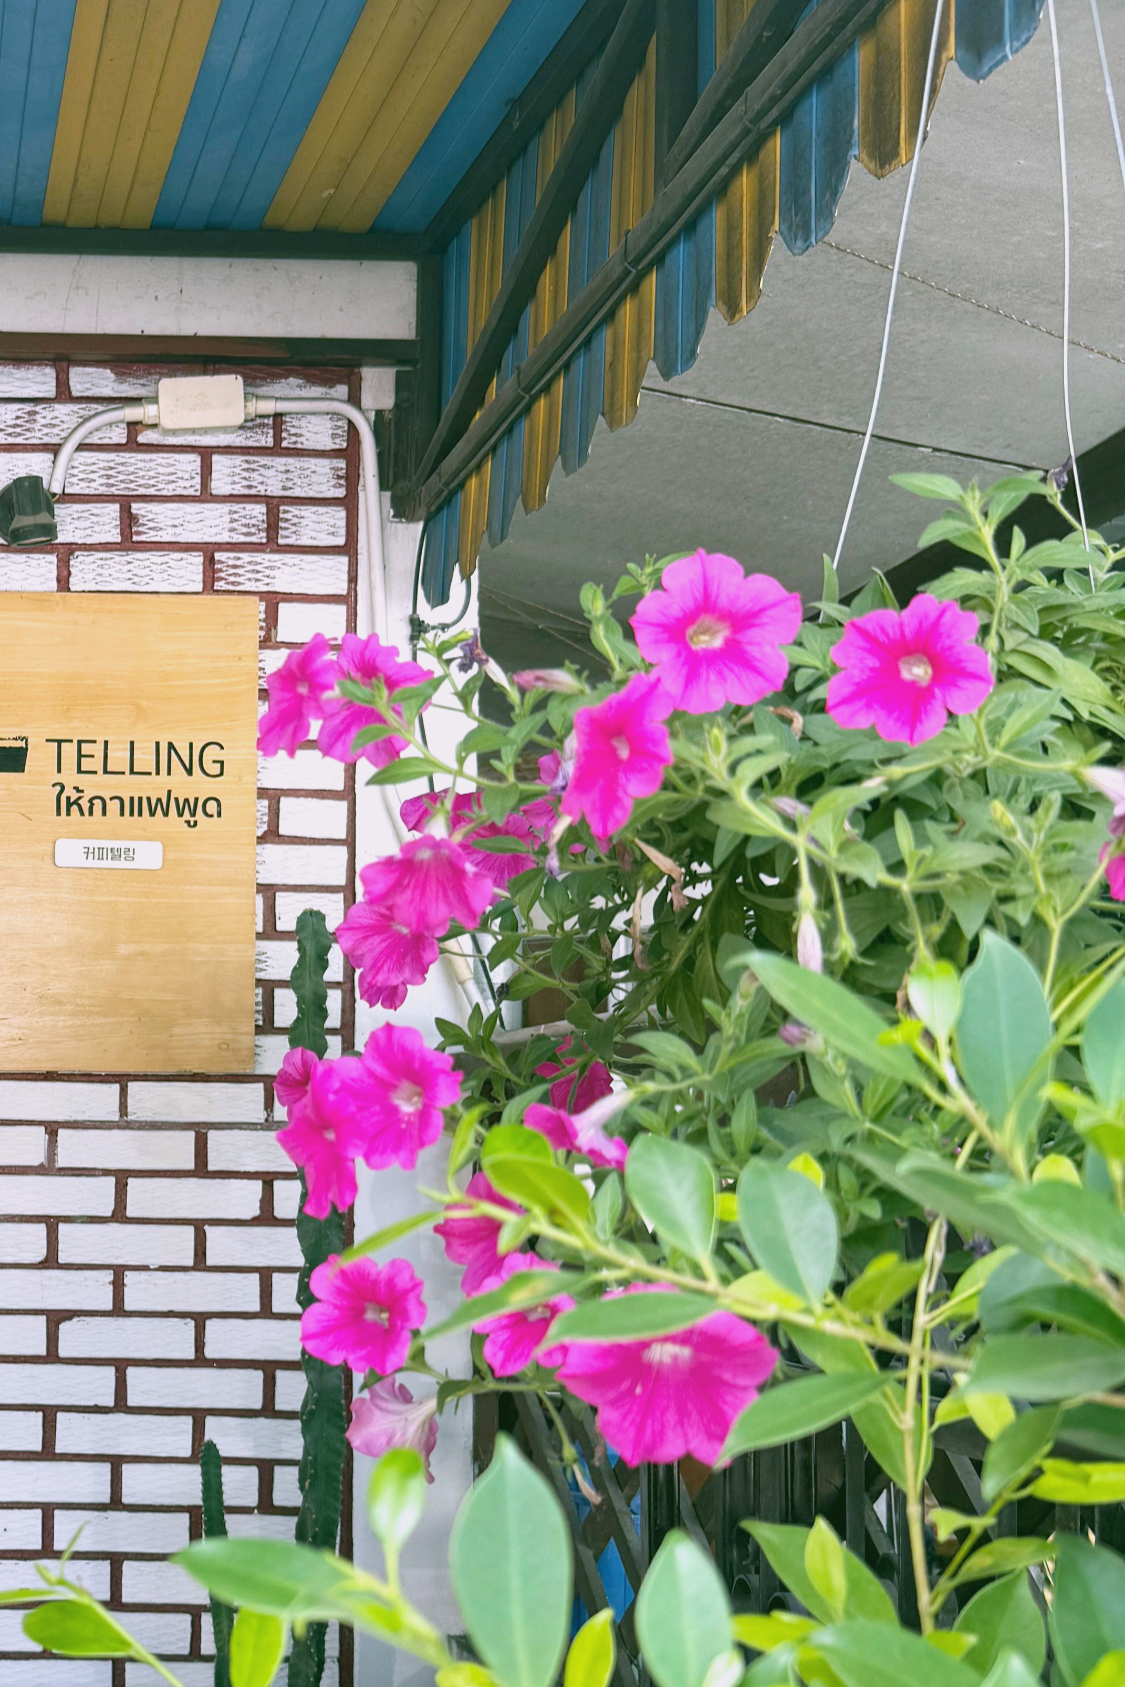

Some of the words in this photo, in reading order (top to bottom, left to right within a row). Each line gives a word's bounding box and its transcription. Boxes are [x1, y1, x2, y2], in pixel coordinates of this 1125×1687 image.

[45, 738, 225, 778] TELLING
[52, 782, 222, 828] ให้กาแฟพูด
[83, 846, 136, 862] 커피텔링
